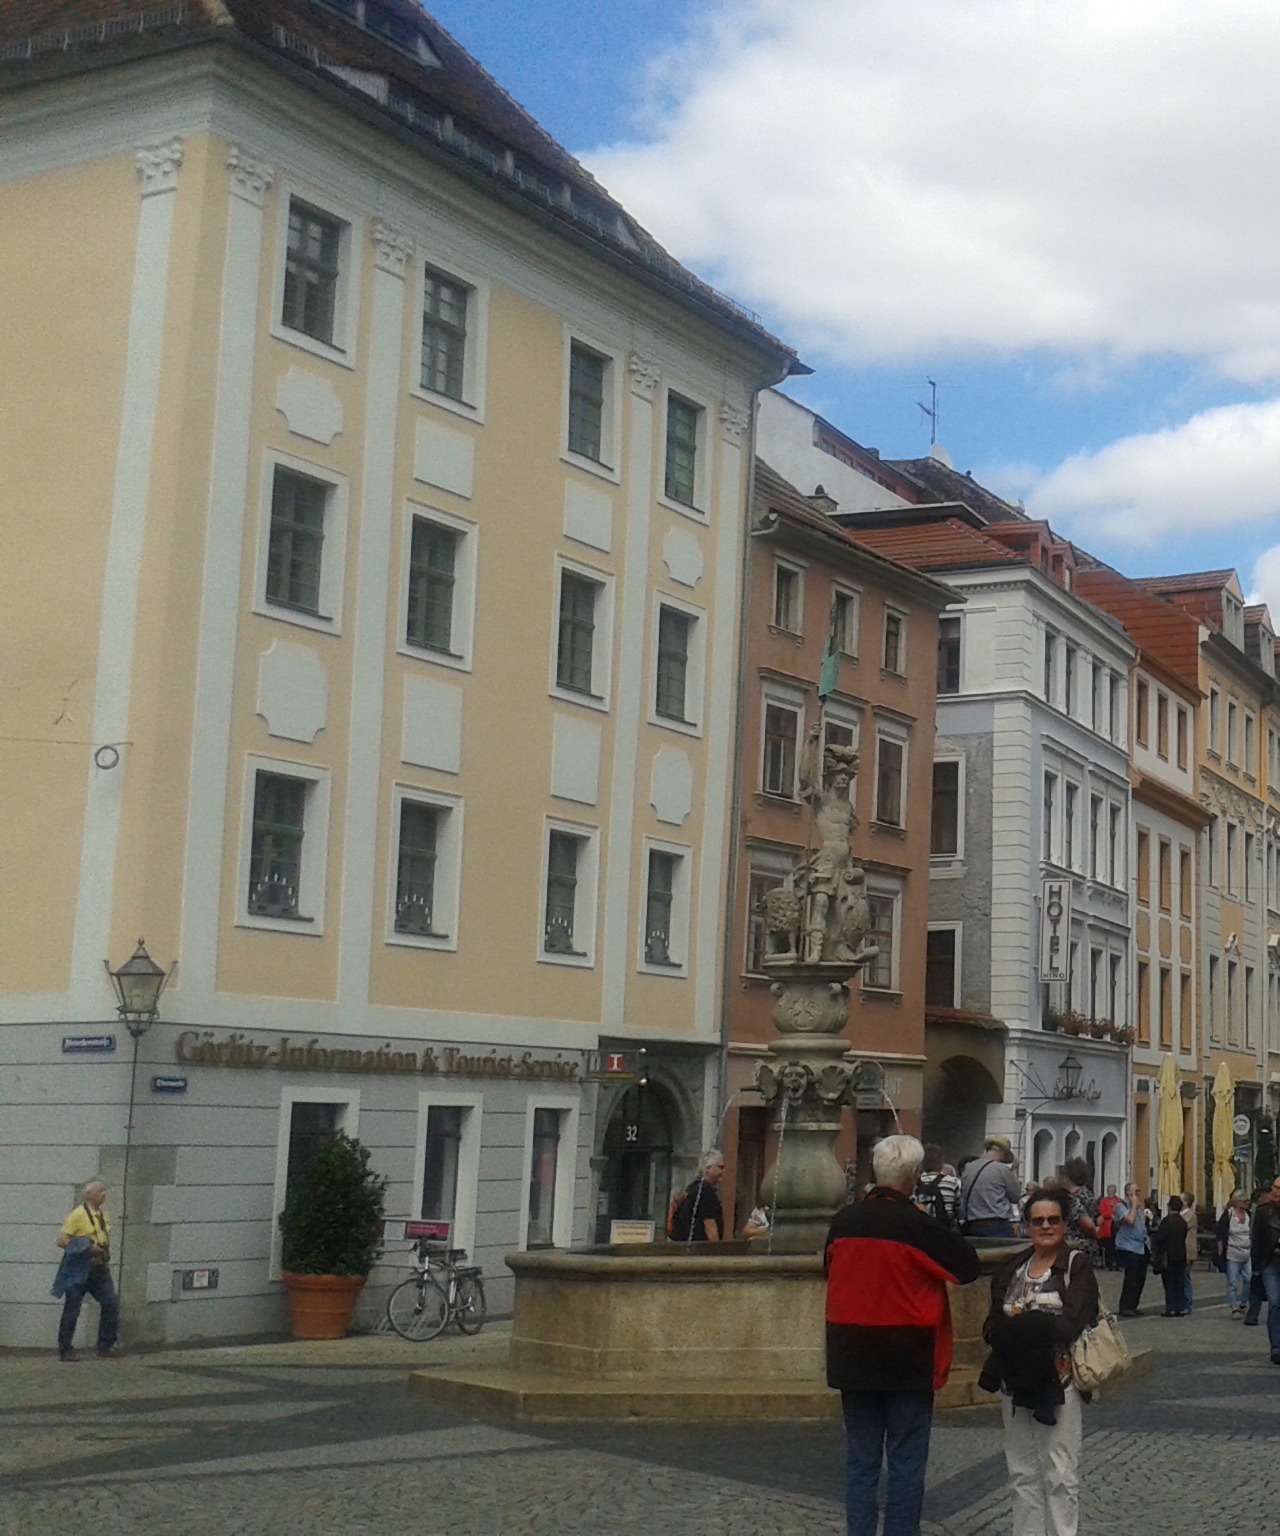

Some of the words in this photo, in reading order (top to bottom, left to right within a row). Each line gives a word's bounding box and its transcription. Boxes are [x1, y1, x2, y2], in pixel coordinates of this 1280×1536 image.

[1046, 884, 1063, 971] HOTEL
[175, 1030, 417, 1072] Görlitz-Information
[421, 1046, 439, 1073] &
[443, 1047, 579, 1081] Tourist-Service
[626, 1125, 638, 1142] 32
